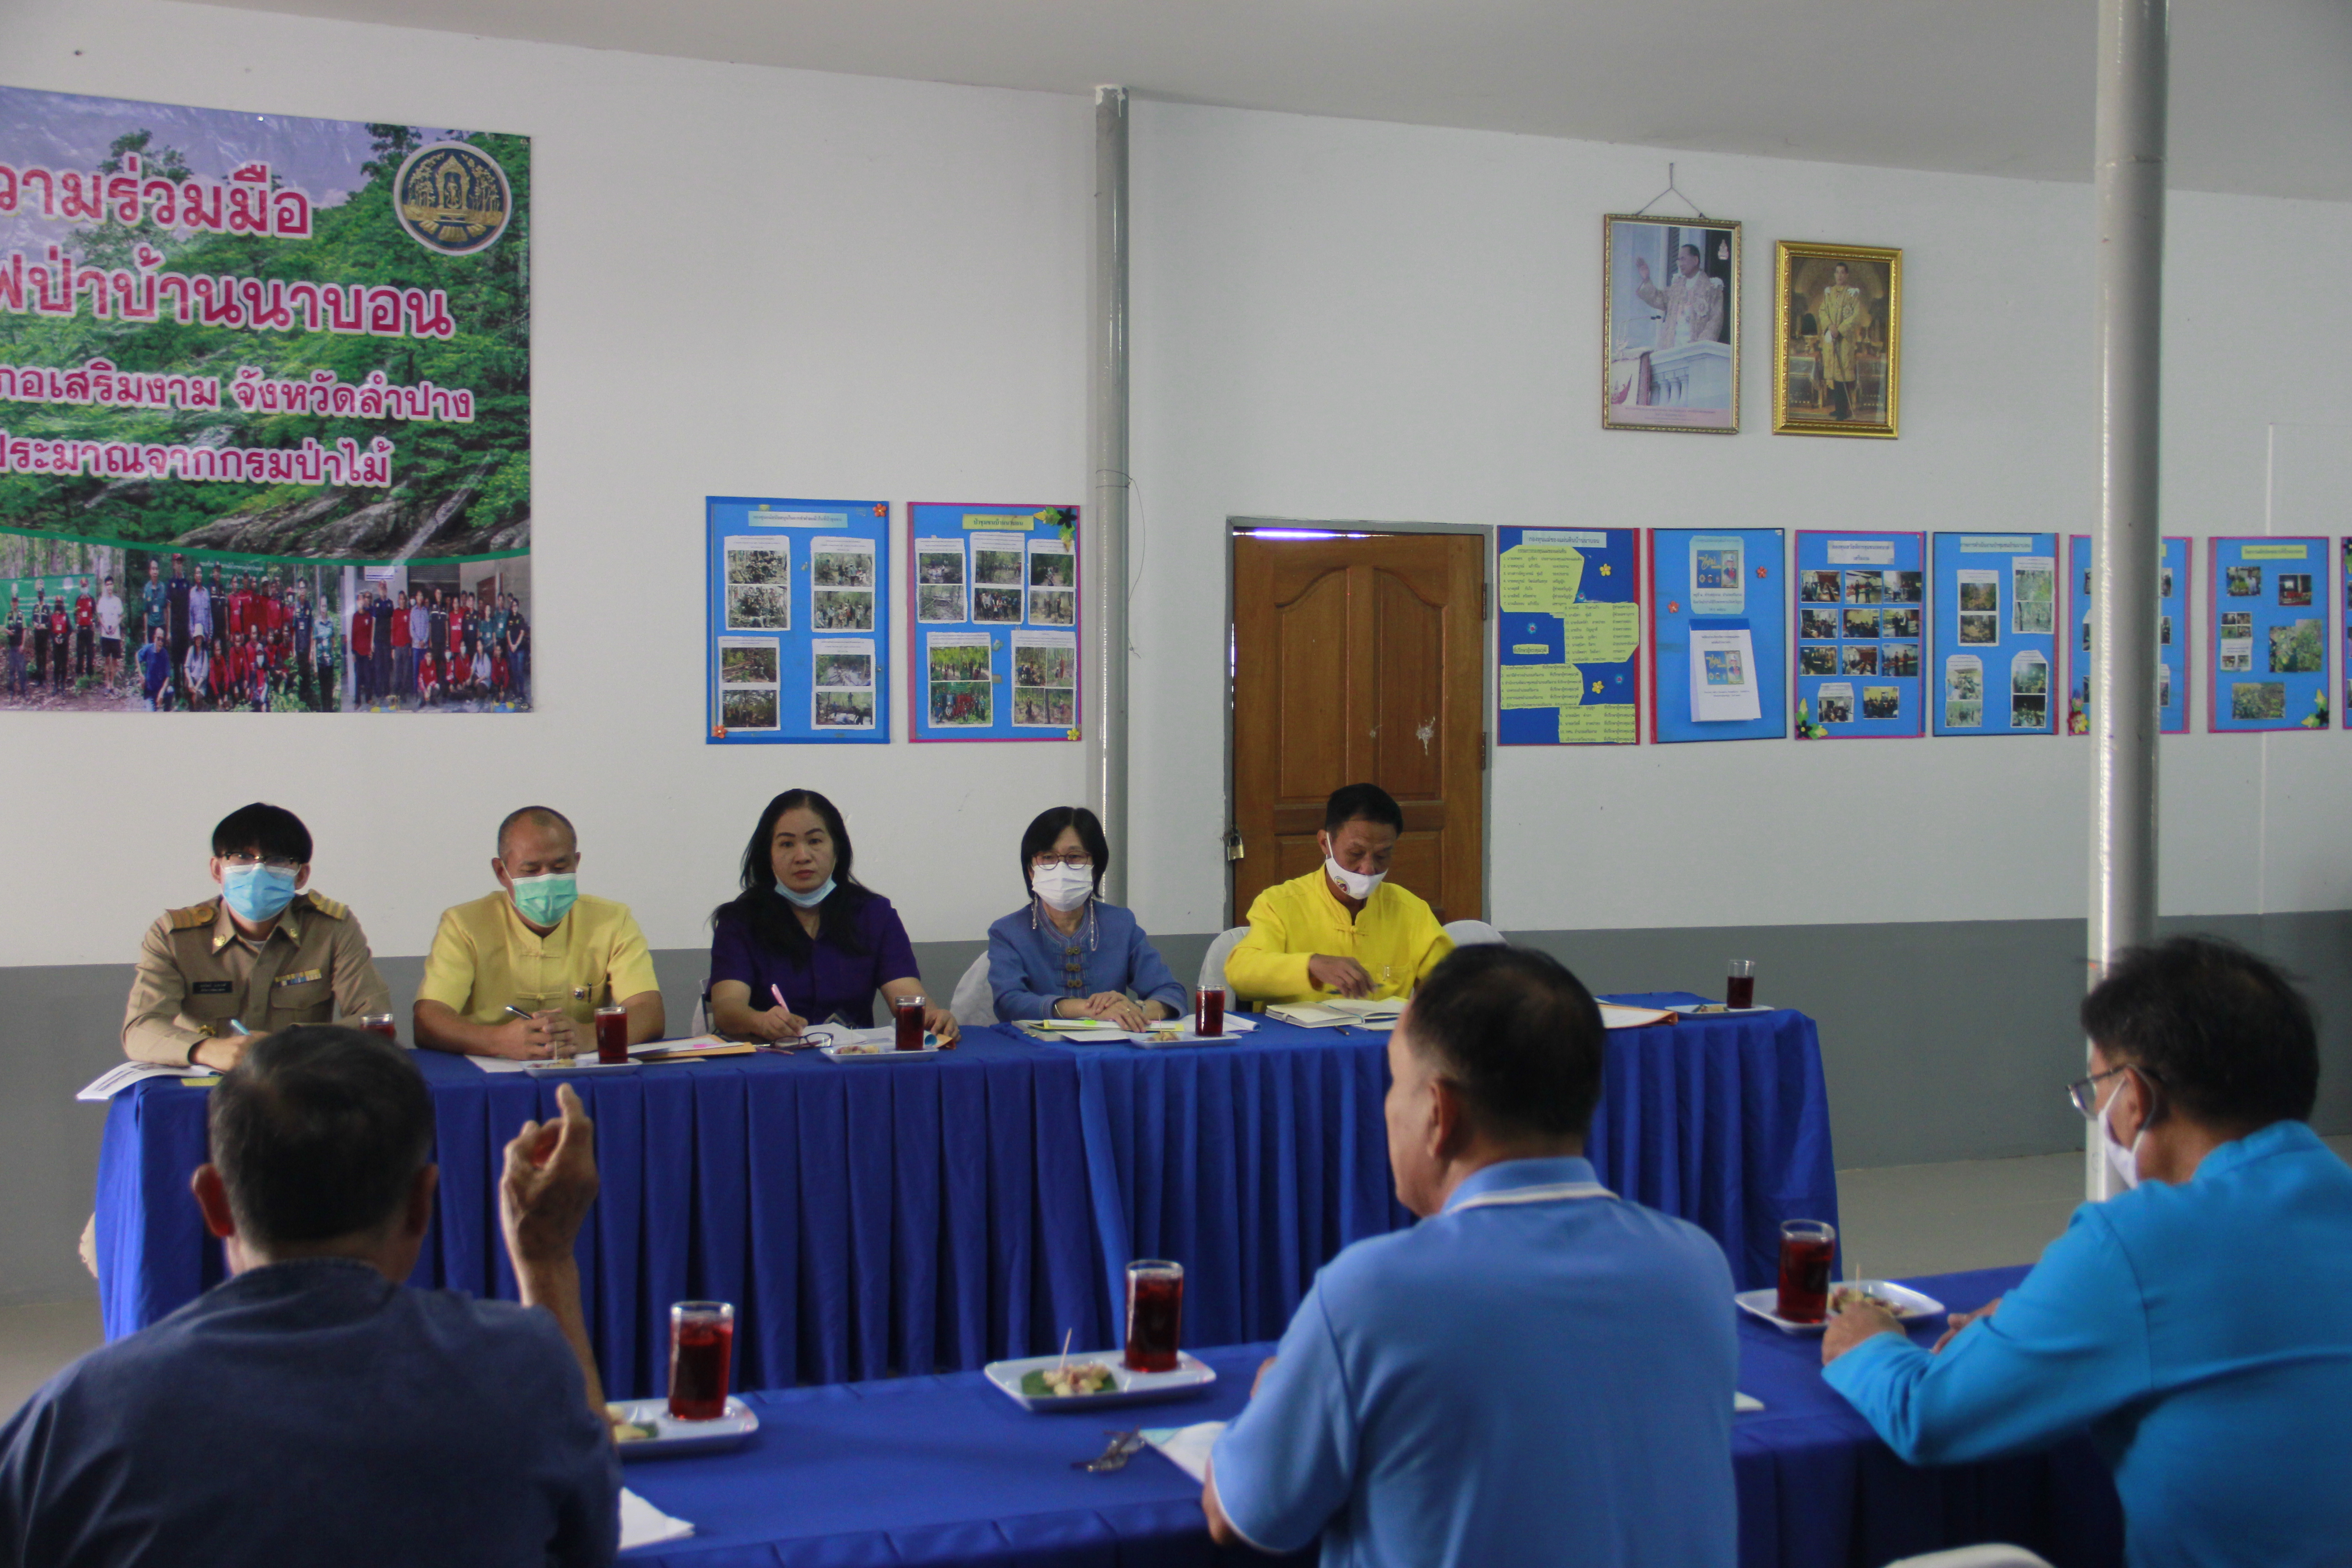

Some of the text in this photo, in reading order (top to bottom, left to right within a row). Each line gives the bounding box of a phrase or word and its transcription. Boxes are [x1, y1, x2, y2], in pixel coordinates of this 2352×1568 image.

[234, 369, 471, 418] จังหวัดลำปาง
[0, 434, 390, 483] ระมาณจากกรมป่าไม้
